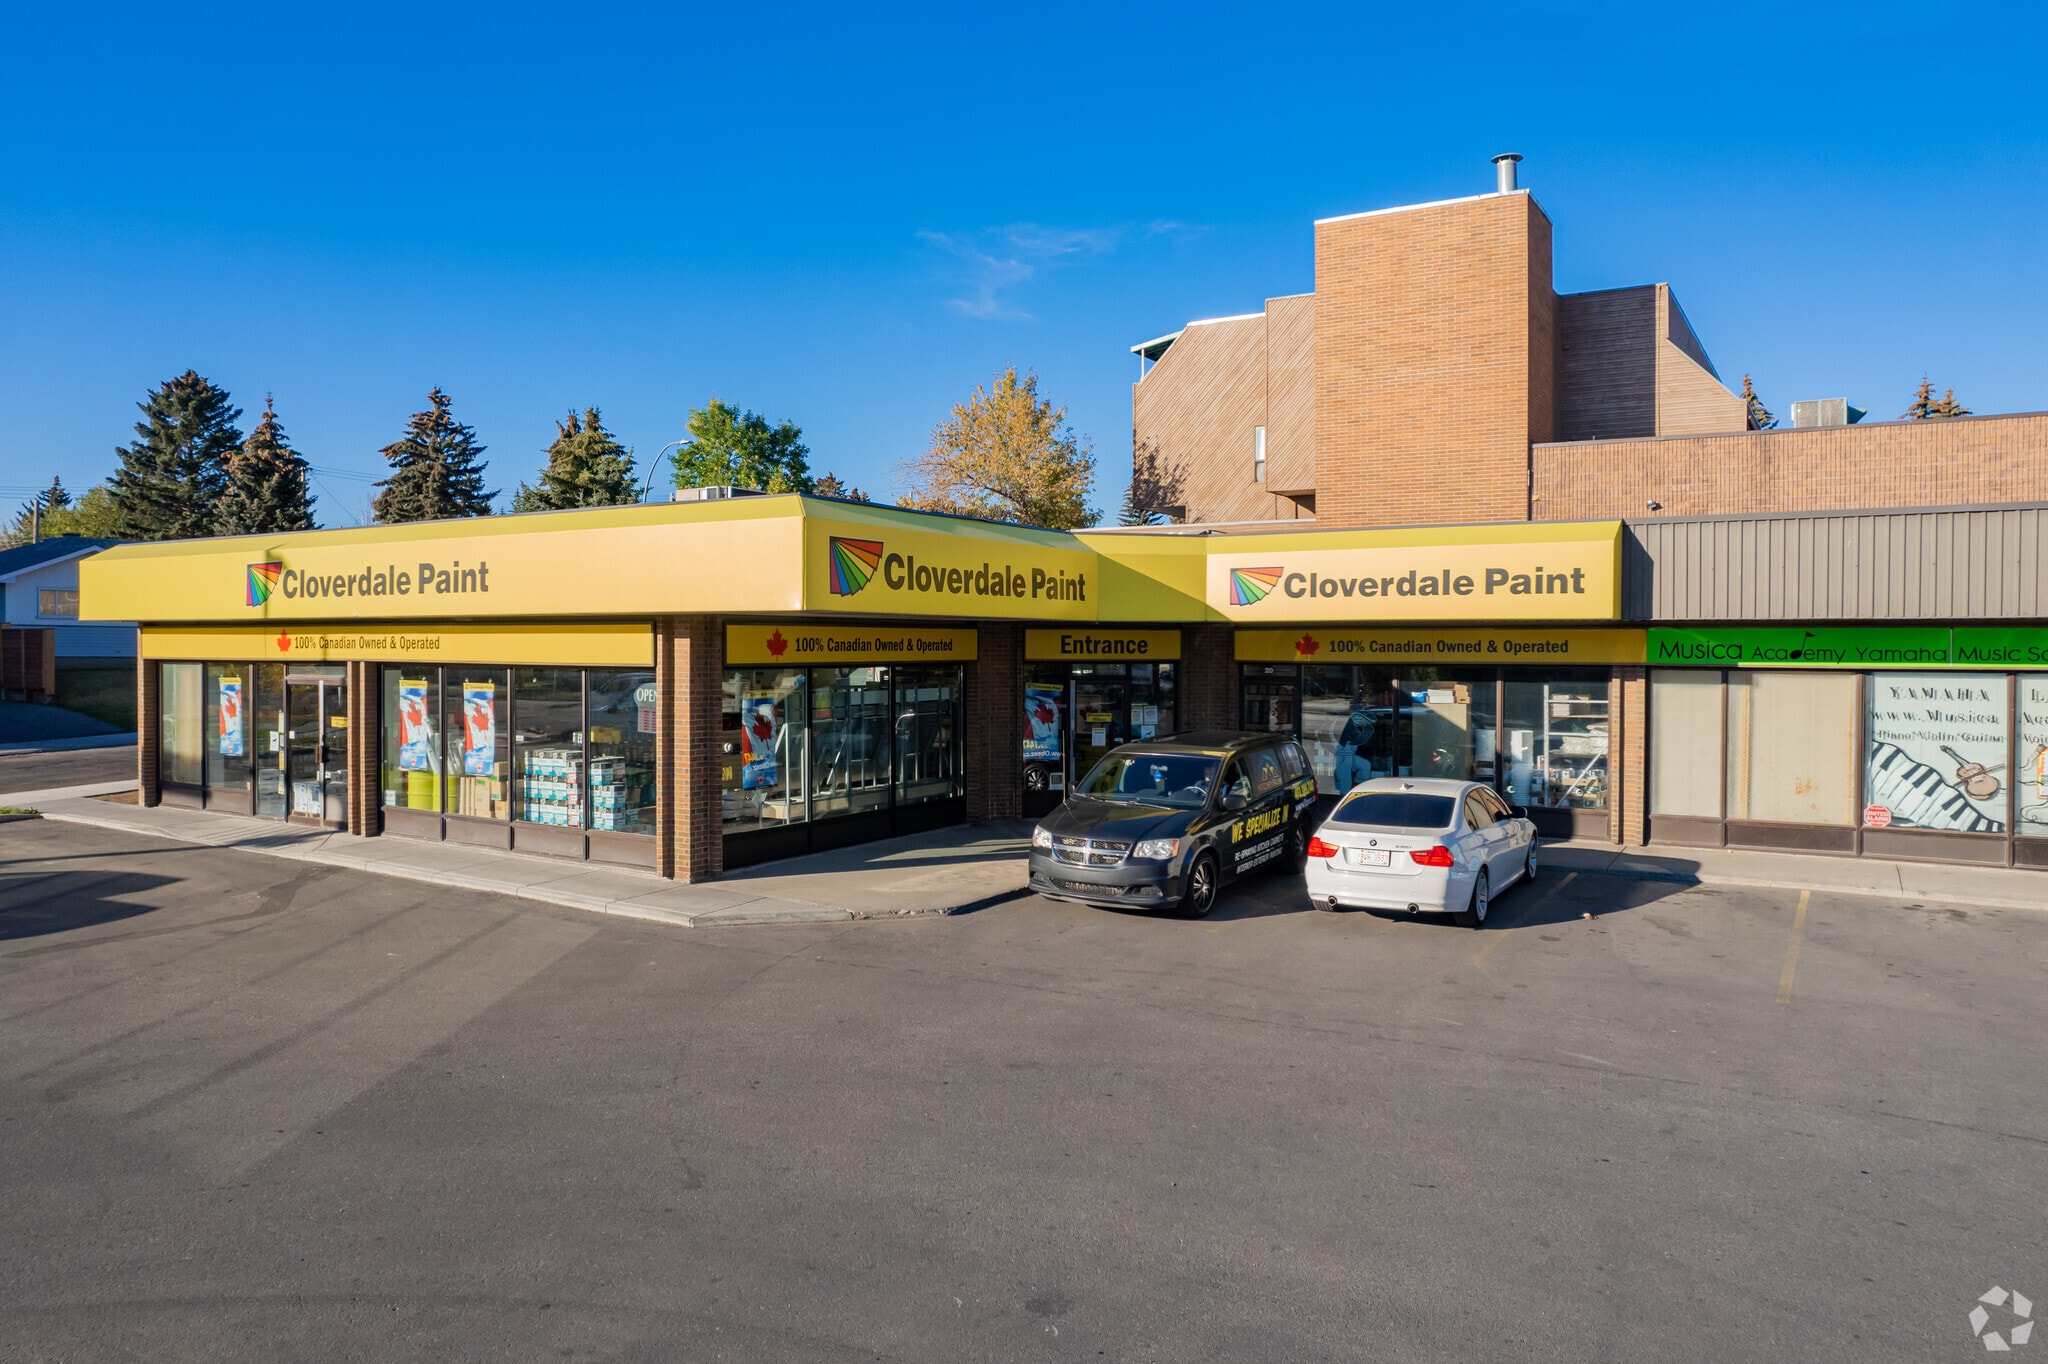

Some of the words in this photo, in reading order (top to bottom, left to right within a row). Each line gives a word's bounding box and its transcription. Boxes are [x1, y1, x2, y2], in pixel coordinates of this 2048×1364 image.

[283, 564, 411, 599] Cloverdale
[418, 560, 489, 594] Paint
[883, 552, 1026, 598] Cloverdale
[1031, 567, 1086, 602] Paint
[1283, 568, 1475, 599] Cloverdale
[1485, 567, 1586, 595] Paint
[294, 636, 316, 649] 100%
[319, 636, 356, 650] Canadian
[359, 636, 387, 650] Owned
[390, 637, 397, 650] &
[400, 636, 440, 652] Operated
[795, 637, 824, 652] 100%
[827, 636, 872, 653] Canadian
[874, 637, 904, 653] Owned
[906, 639, 914, 653] &
[916, 638, 953, 654] Operated
[1060, 634, 1148, 655] Entrance
[1329, 640, 1365, 653] 100%
[1369, 640, 1432, 653] Canadian
[1436, 640, 1482, 654] Owned
[1486, 641, 1498, 654] &
[1503, 640, 1569, 656] Operated
[1658, 640, 1743, 660] Musica
[1751, 631, 1846, 665] Academy
[1855, 647, 1947, 662] Yamaha
[1957, 646, 2021, 662] Music
[1889, 687, 1989, 700] YAMAHA
[1231, 821, 1244, 844] WE
[1245, 807, 1281, 839] SPECIALIZE
